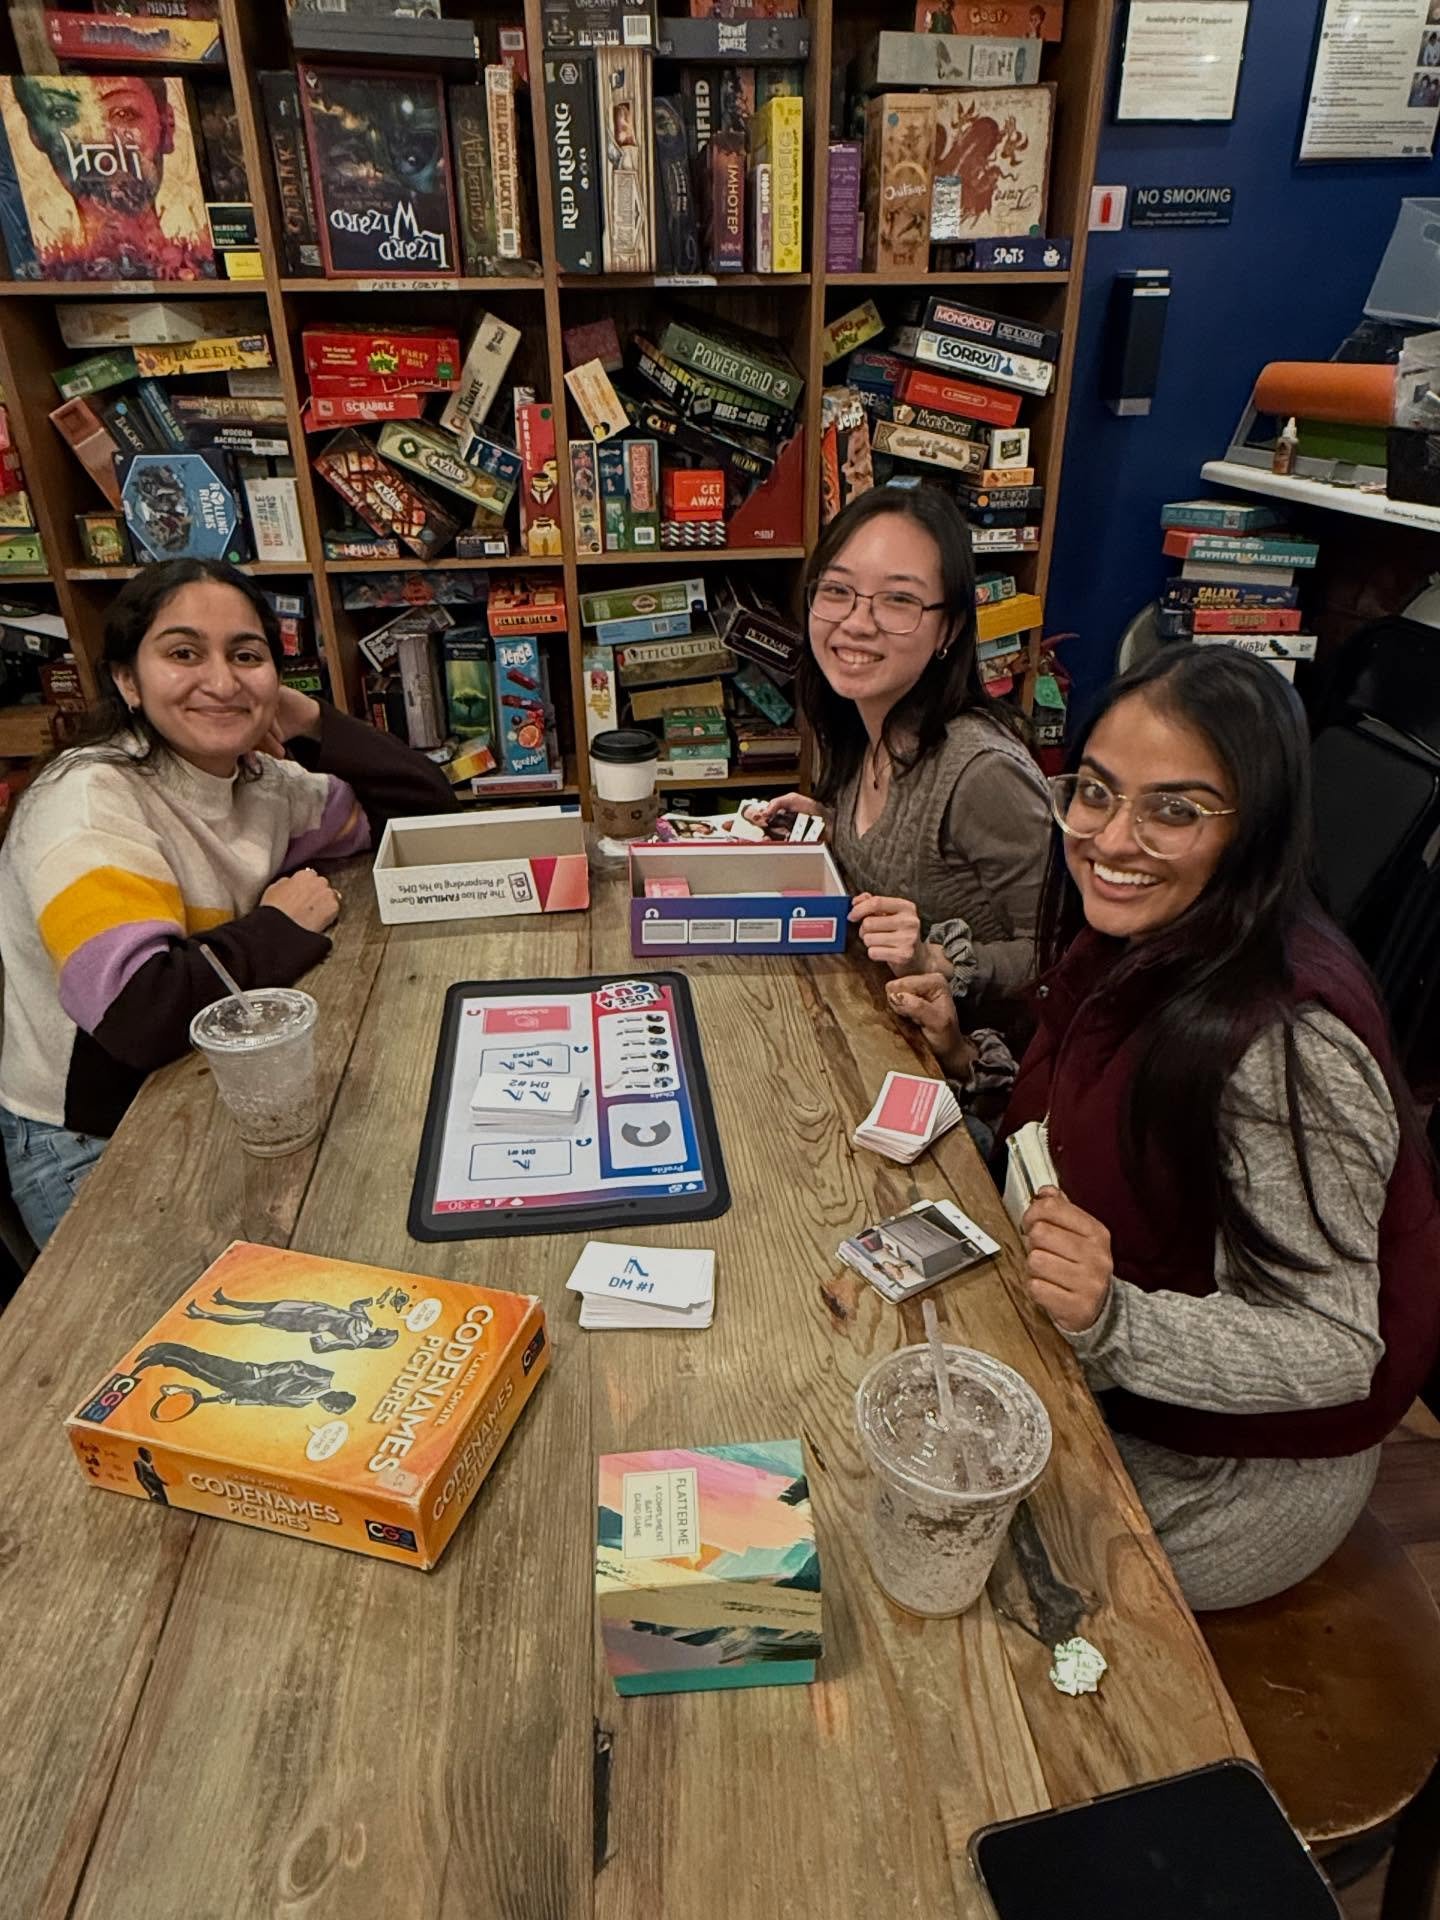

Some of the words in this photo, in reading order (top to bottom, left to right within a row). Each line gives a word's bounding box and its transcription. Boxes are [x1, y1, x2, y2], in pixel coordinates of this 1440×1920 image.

[554, 102, 577, 181] RISING
[726, 164, 739, 235] IMHOTEP
[1137, 189, 1160, 205] NO
[1162, 188, 1232, 204] SMOKING
[560, 186, 579, 230] RED
[936, 310, 994, 333] MONOPOLY
[941, 341, 997, 370] SORRY!
[692, 342, 738, 380] POWER
[739, 365, 773, 392] GRID
[344, 399, 394, 413] SCRABBLE
[714, 402, 739, 420] HUES
[746, 410, 770, 428] CUES
[114, 415, 145, 452] BACKG
[433, 458, 466, 481] AZUL
[376, 484, 402, 510] AZUL
[700, 484, 721, 495] GET
[1198, 587, 1240, 600] GALAXY
[501, 643, 534, 666] Jenga
[418, 883, 432, 893] His
[433, 883, 443, 892] to
[443, 878, 493, 891] Responding
[489, 889, 505, 899] The
[390, 896, 416, 905] Game
[416, 892, 460, 904] FAMILIAR
[598, 984, 650, 1003] GUY
[602, 999, 613, 1008] A
[616, 992, 655, 1006] LOSE
[508, 1079, 527, 1088] #2
[530, 1080, 550, 1088] DM
[521, 1148, 536, 1156] DM
[651, 1164, 684, 1174] Profile
[607, 1276, 634, 1291] DM
[635, 1280, 654, 1294] #1
[368, 1303, 495, 1475] CODENAMES
[371, 1335, 444, 1425] PICTURES
[431, 1380, 515, 1522] CODENAMES
[188, 1472, 343, 1526] CODENAMES
[633, 1492, 641, 1514] CARD
[675, 1478, 689, 1526] FLATTER
[228, 1501, 310, 1532] PICTURES
[644, 1499, 653, 1528] BATTLE
[655, 1491, 664, 1542] COMPLIMENT
[634, 1516, 642, 1537] GAME
[678, 1528, 689, 1546] ME
